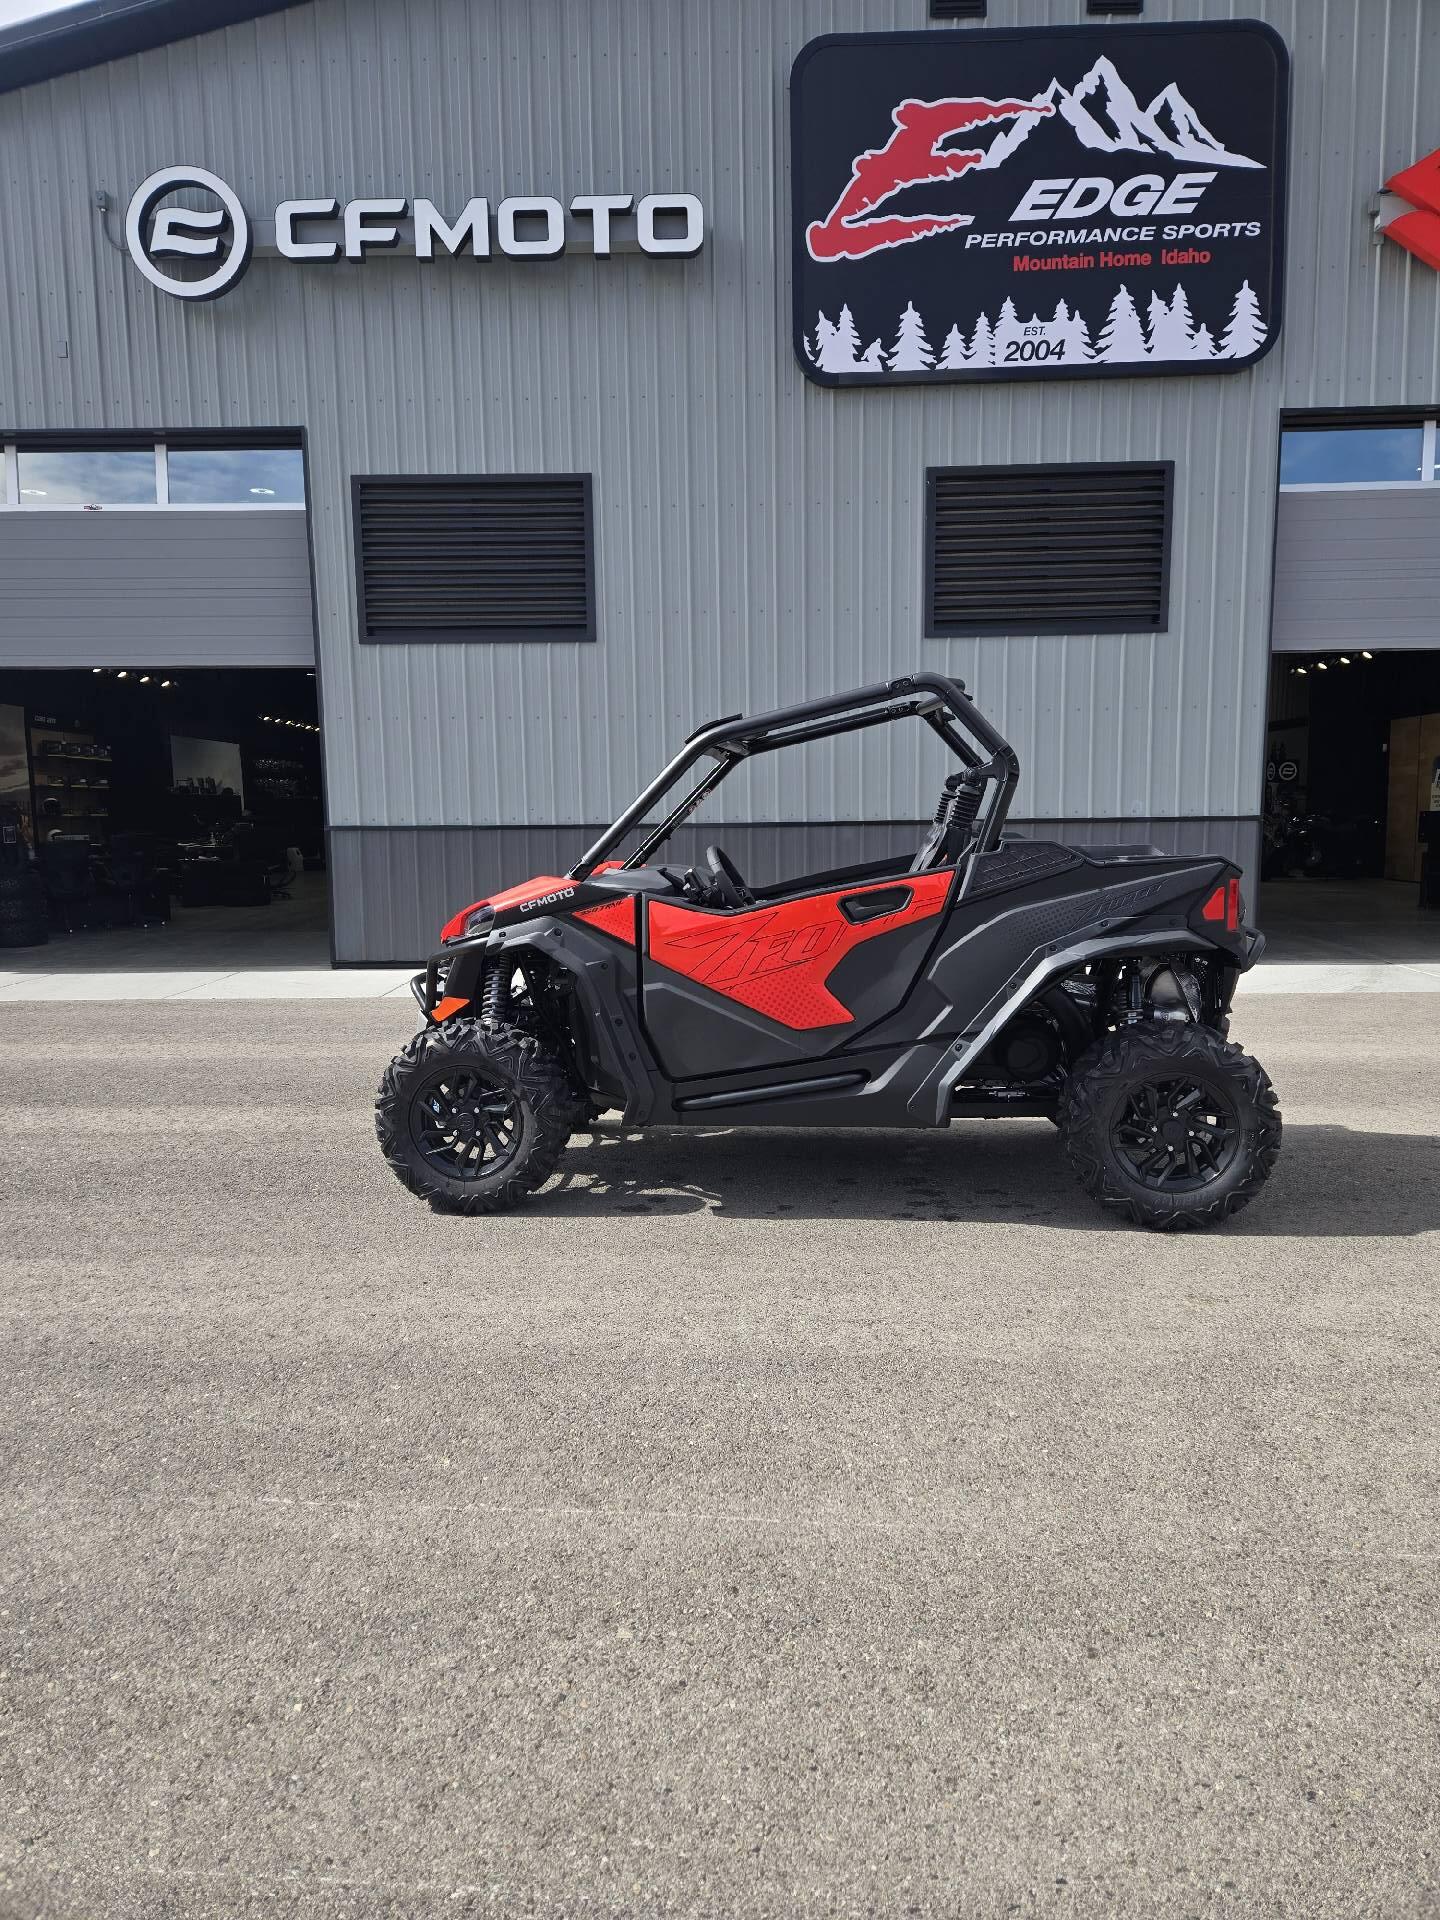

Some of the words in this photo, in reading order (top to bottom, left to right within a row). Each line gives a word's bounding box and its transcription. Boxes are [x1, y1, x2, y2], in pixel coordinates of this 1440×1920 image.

[1008, 171, 1218, 221] EDGE
[274, 193, 704, 258] CFMOTO
[965, 226, 1156, 249] PERFORMANCE
[1162, 221, 1261, 241] SPORTS
[1013, 256, 1095, 272] Mountain
[1100, 250, 1152, 268] Home
[1161, 247, 1211, 265] Idaho
[1023, 326, 1046, 336] EST.
[1004, 338, 1066, 362] 2004
[519, 886, 575, 913] CFMOTO
